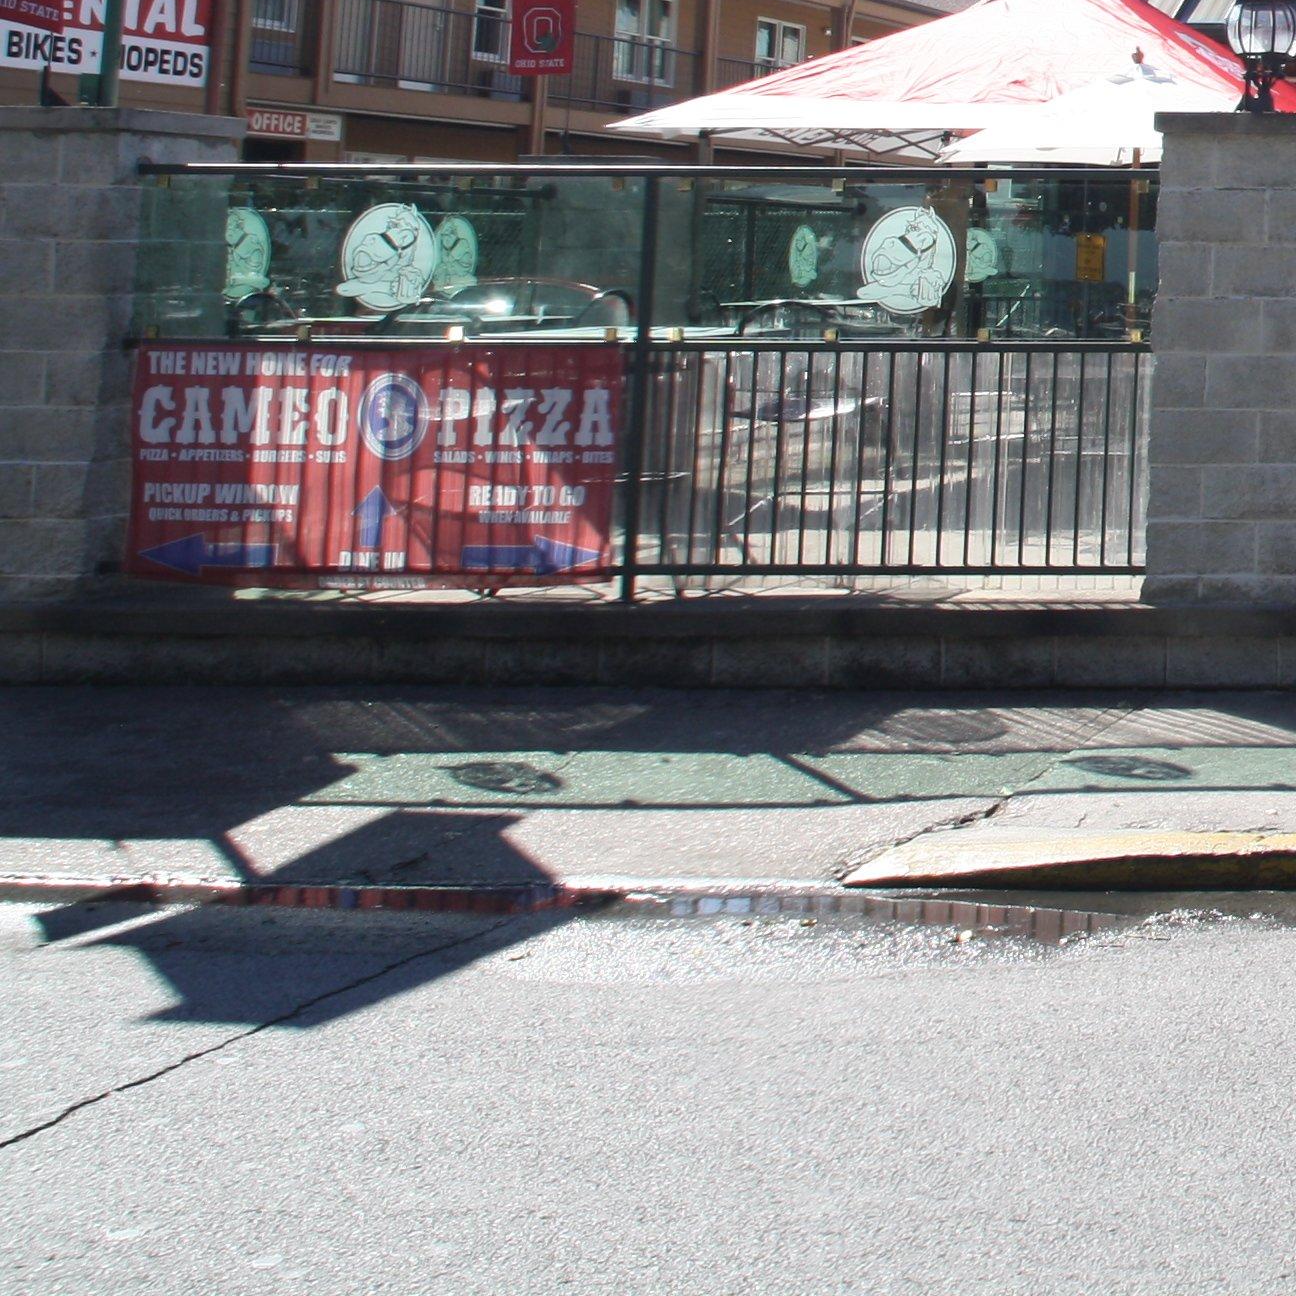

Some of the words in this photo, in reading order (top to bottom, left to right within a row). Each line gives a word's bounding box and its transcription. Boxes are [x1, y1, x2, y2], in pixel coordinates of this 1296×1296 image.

[20, 0, 60, 21] STATE
[7, 30, 83, 65] BIKES
[515, 59, 536, 68] OHIO
[539, 58, 565, 68] STATE
[252, 112, 303, 134] OFFICE
[148, 351, 186, 375] THE
[191, 352, 241, 375] NEW
[246, 352, 307, 376] HOME
[310, 354, 353, 377] FOR
[138, 384, 349, 446] CAMEO
[437, 387, 616, 447] PIZZA
[139, 448, 170, 461] PIZZA
[178, 449, 244, 462] APPETIZERS
[253, 449, 306, 463] BURGERS
[433, 451, 475, 464] SALADS
[485, 451, 522, 464] WINGS
[532, 451, 573, 464] WRAPS
[143, 482, 211, 503] PICKUP
[214, 483, 300, 505] WINDOW
[469, 485, 528, 506] READY
[531, 485, 556, 506] TO
[559, 485, 586, 507] GO
[149, 507, 183, 522] QUICK
[184, 508, 228, 522] ORDERS
[230, 510, 240, 522] &
[479, 510, 511, 523] WHEN
[513, 510, 573, 524] AVAILABLE
[339, 550, 379, 572] DINE
[383, 551, 406, 572] IN
